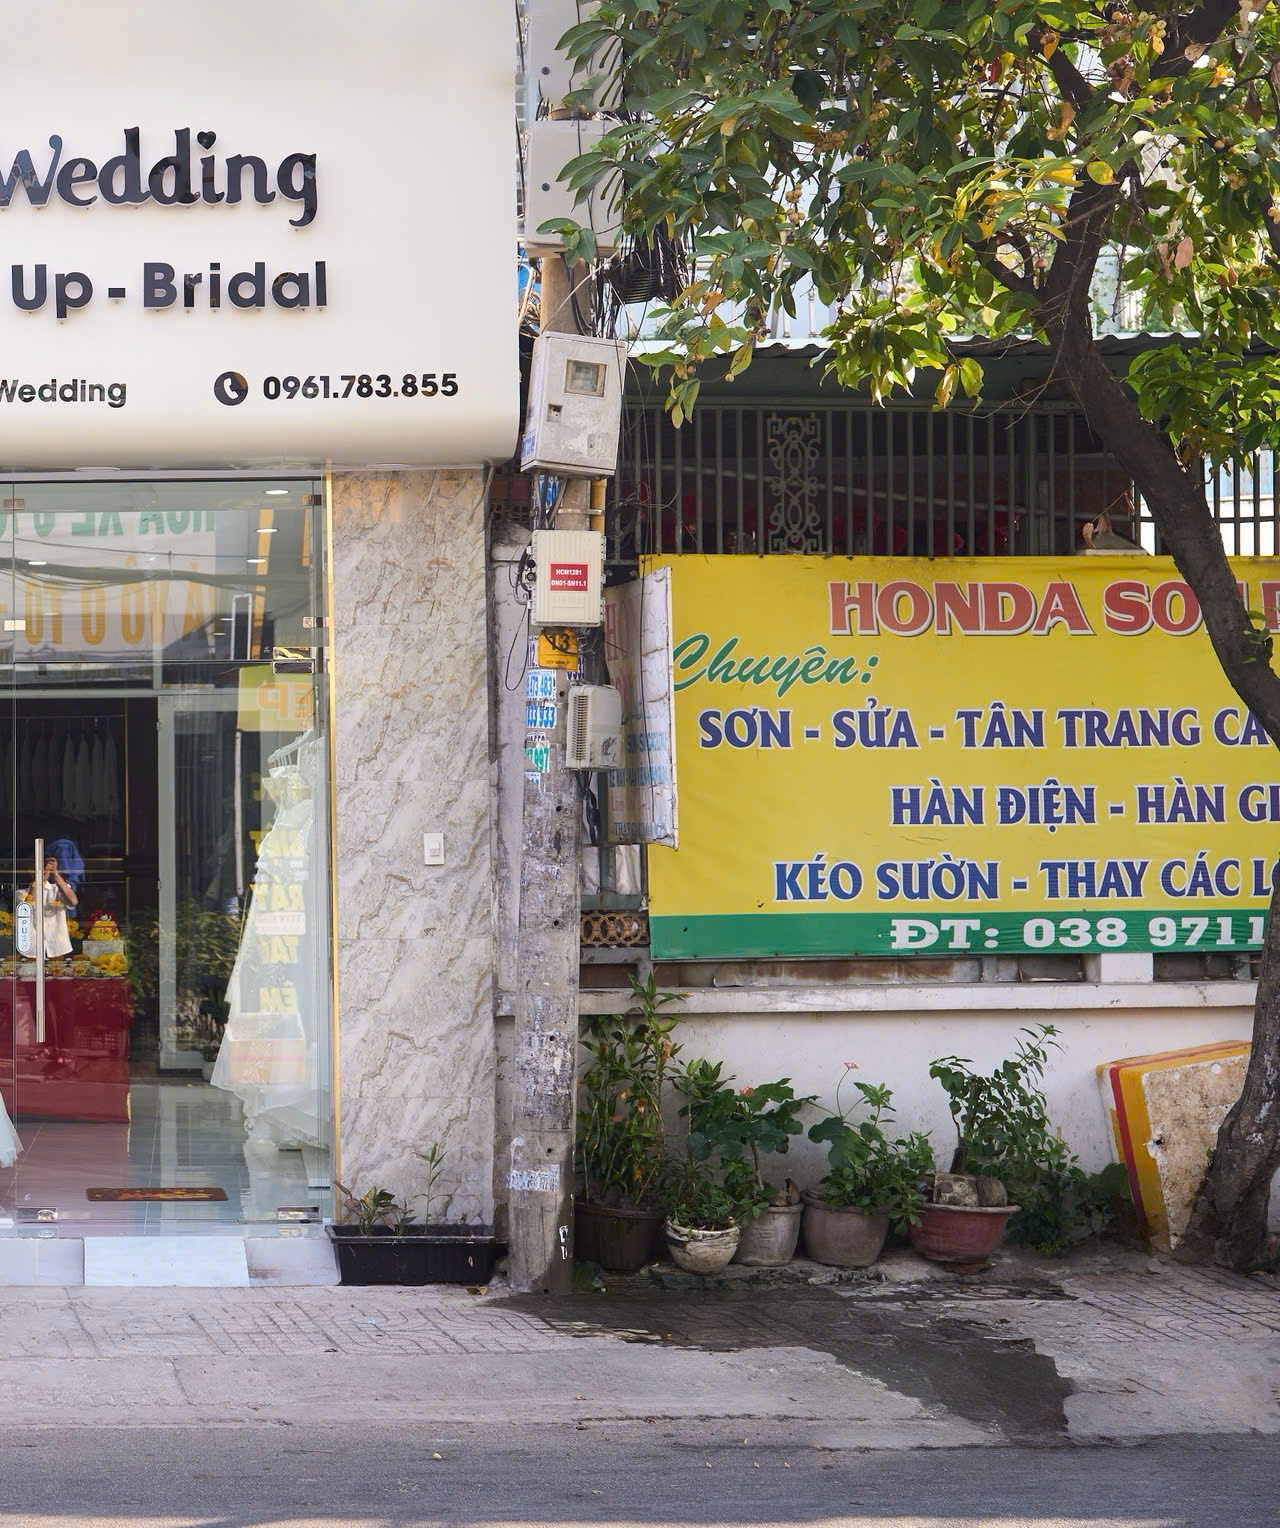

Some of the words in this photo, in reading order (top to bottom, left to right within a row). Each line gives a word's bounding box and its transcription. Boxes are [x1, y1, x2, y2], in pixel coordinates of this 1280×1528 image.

[11, 264, 96, 320] Up
[143, 260, 329, 311] Bridal
[263, 373, 460, 401] 0961.783.855
[829, 579, 1094, 637] HONDA
[673, 632, 880, 698] Chuyên:
[698, 706, 791, 749] SƠN
[832, 697, 919, 748] SỬA
[956, 701, 1045, 748] TÂN
[1057, 708, 1201, 747] TRANG
[891, 777, 985, 826] HÀN
[996, 777, 1096, 833] ĐIỆN
[1136, 775, 1227, 824] HÀN
[774, 853, 863, 901] KÉO
[875, 852, 999, 901] SƯỜN
[1039, 859, 1148, 900] THAY
[1160, 853, 1239, 899] CÁC
[890, 919, 1000, 951] ĐT:
[1023, 917, 1130, 951] 038
